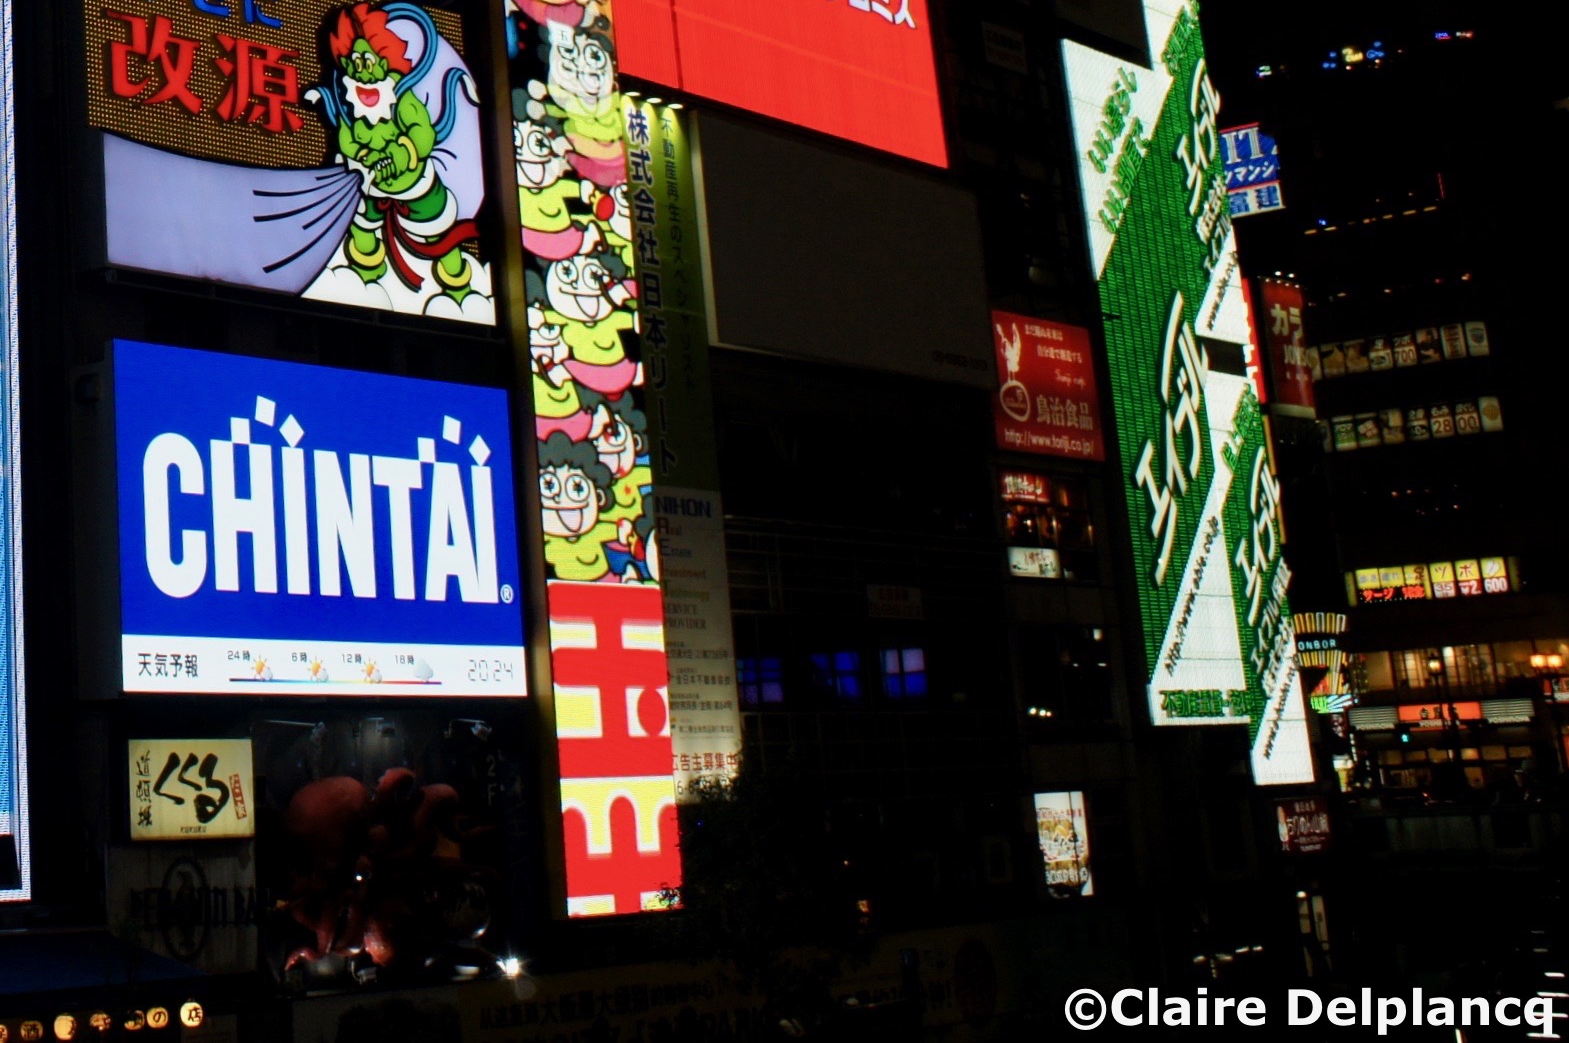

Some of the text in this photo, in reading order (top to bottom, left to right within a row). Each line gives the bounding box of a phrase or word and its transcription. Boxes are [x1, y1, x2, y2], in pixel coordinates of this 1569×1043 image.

[106, 9, 305, 135] 改源
[142, 395, 500, 605] CHINTAI
[654, 496, 711, 518] NIHON
[137, 651, 199, 679] 天気予報
[153, 751, 230, 824] くくる
